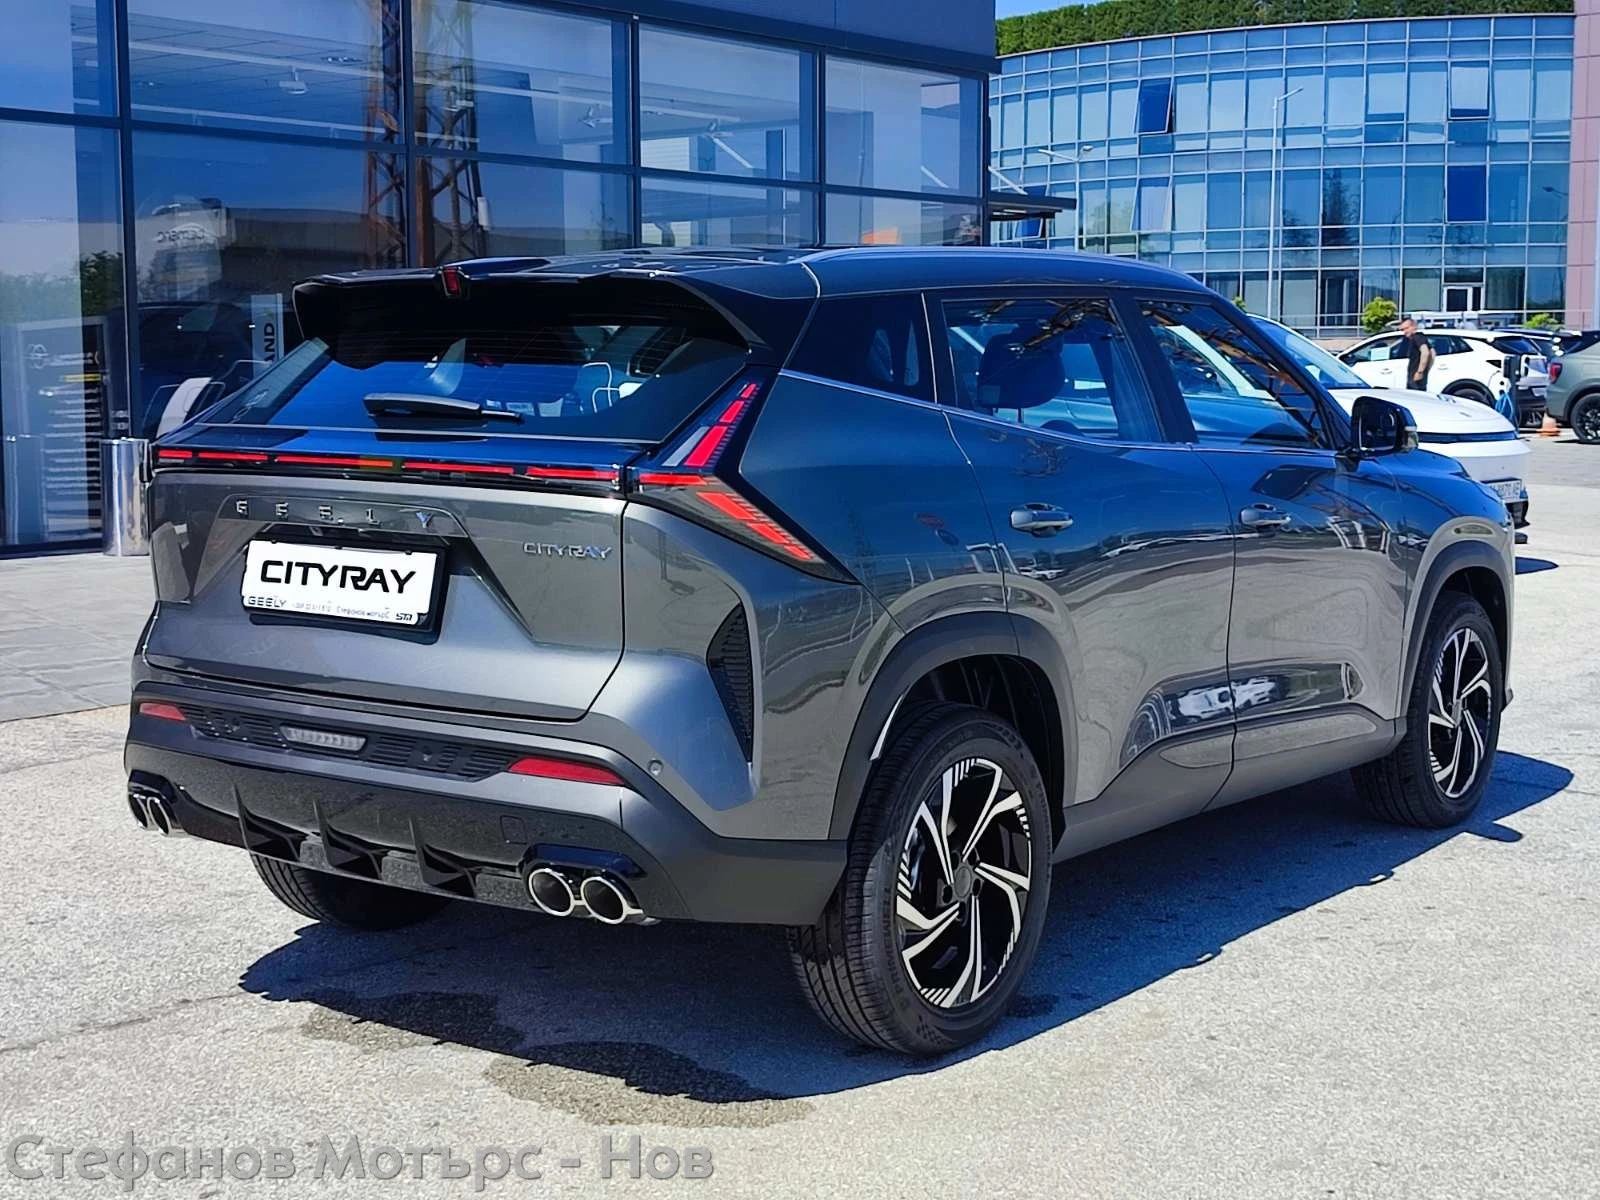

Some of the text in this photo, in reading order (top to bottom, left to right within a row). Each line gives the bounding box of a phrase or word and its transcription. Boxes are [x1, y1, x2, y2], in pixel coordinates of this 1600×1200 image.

[236, 500, 434, 529] GEELY
[523, 542, 613, 560] CITYRAY
[260, 559, 416, 595] CITYRAY
[248, 595, 287, 608] GEELY
